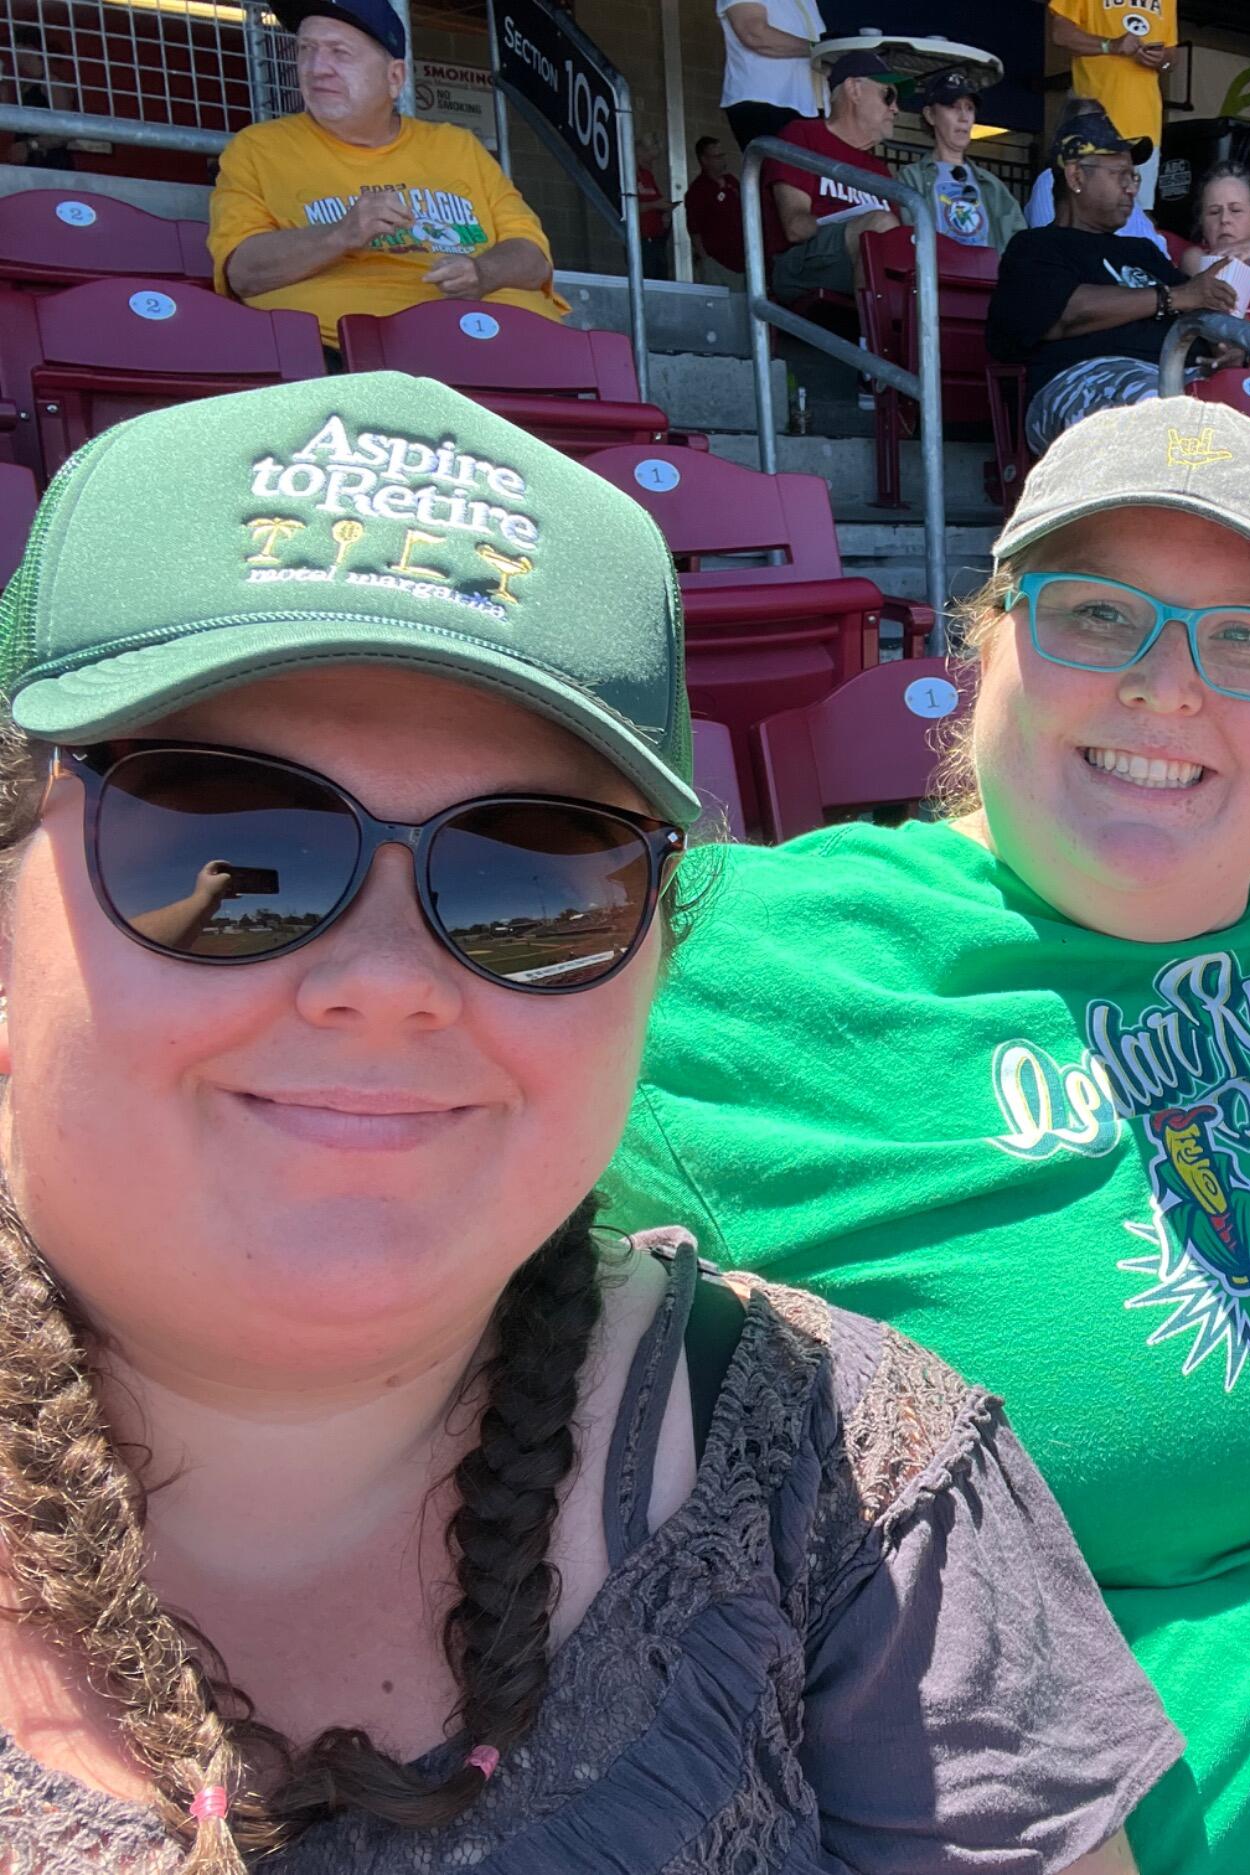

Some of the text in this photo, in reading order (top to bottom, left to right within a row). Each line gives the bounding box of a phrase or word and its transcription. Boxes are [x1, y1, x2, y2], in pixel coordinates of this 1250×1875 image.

[504, 15, 610, 170] SECTION 106
[70, 207, 84, 220] 2
[146, 297, 161, 313] 2
[475, 319, 486, 333] 1
[292, 414, 526, 501] Aspire
[651, 467, 664, 484] 1
[250, 456, 540, 551] to Retire
[926, 688, 940, 709] 1
[989, 998, 1200, 1158] Cedar
